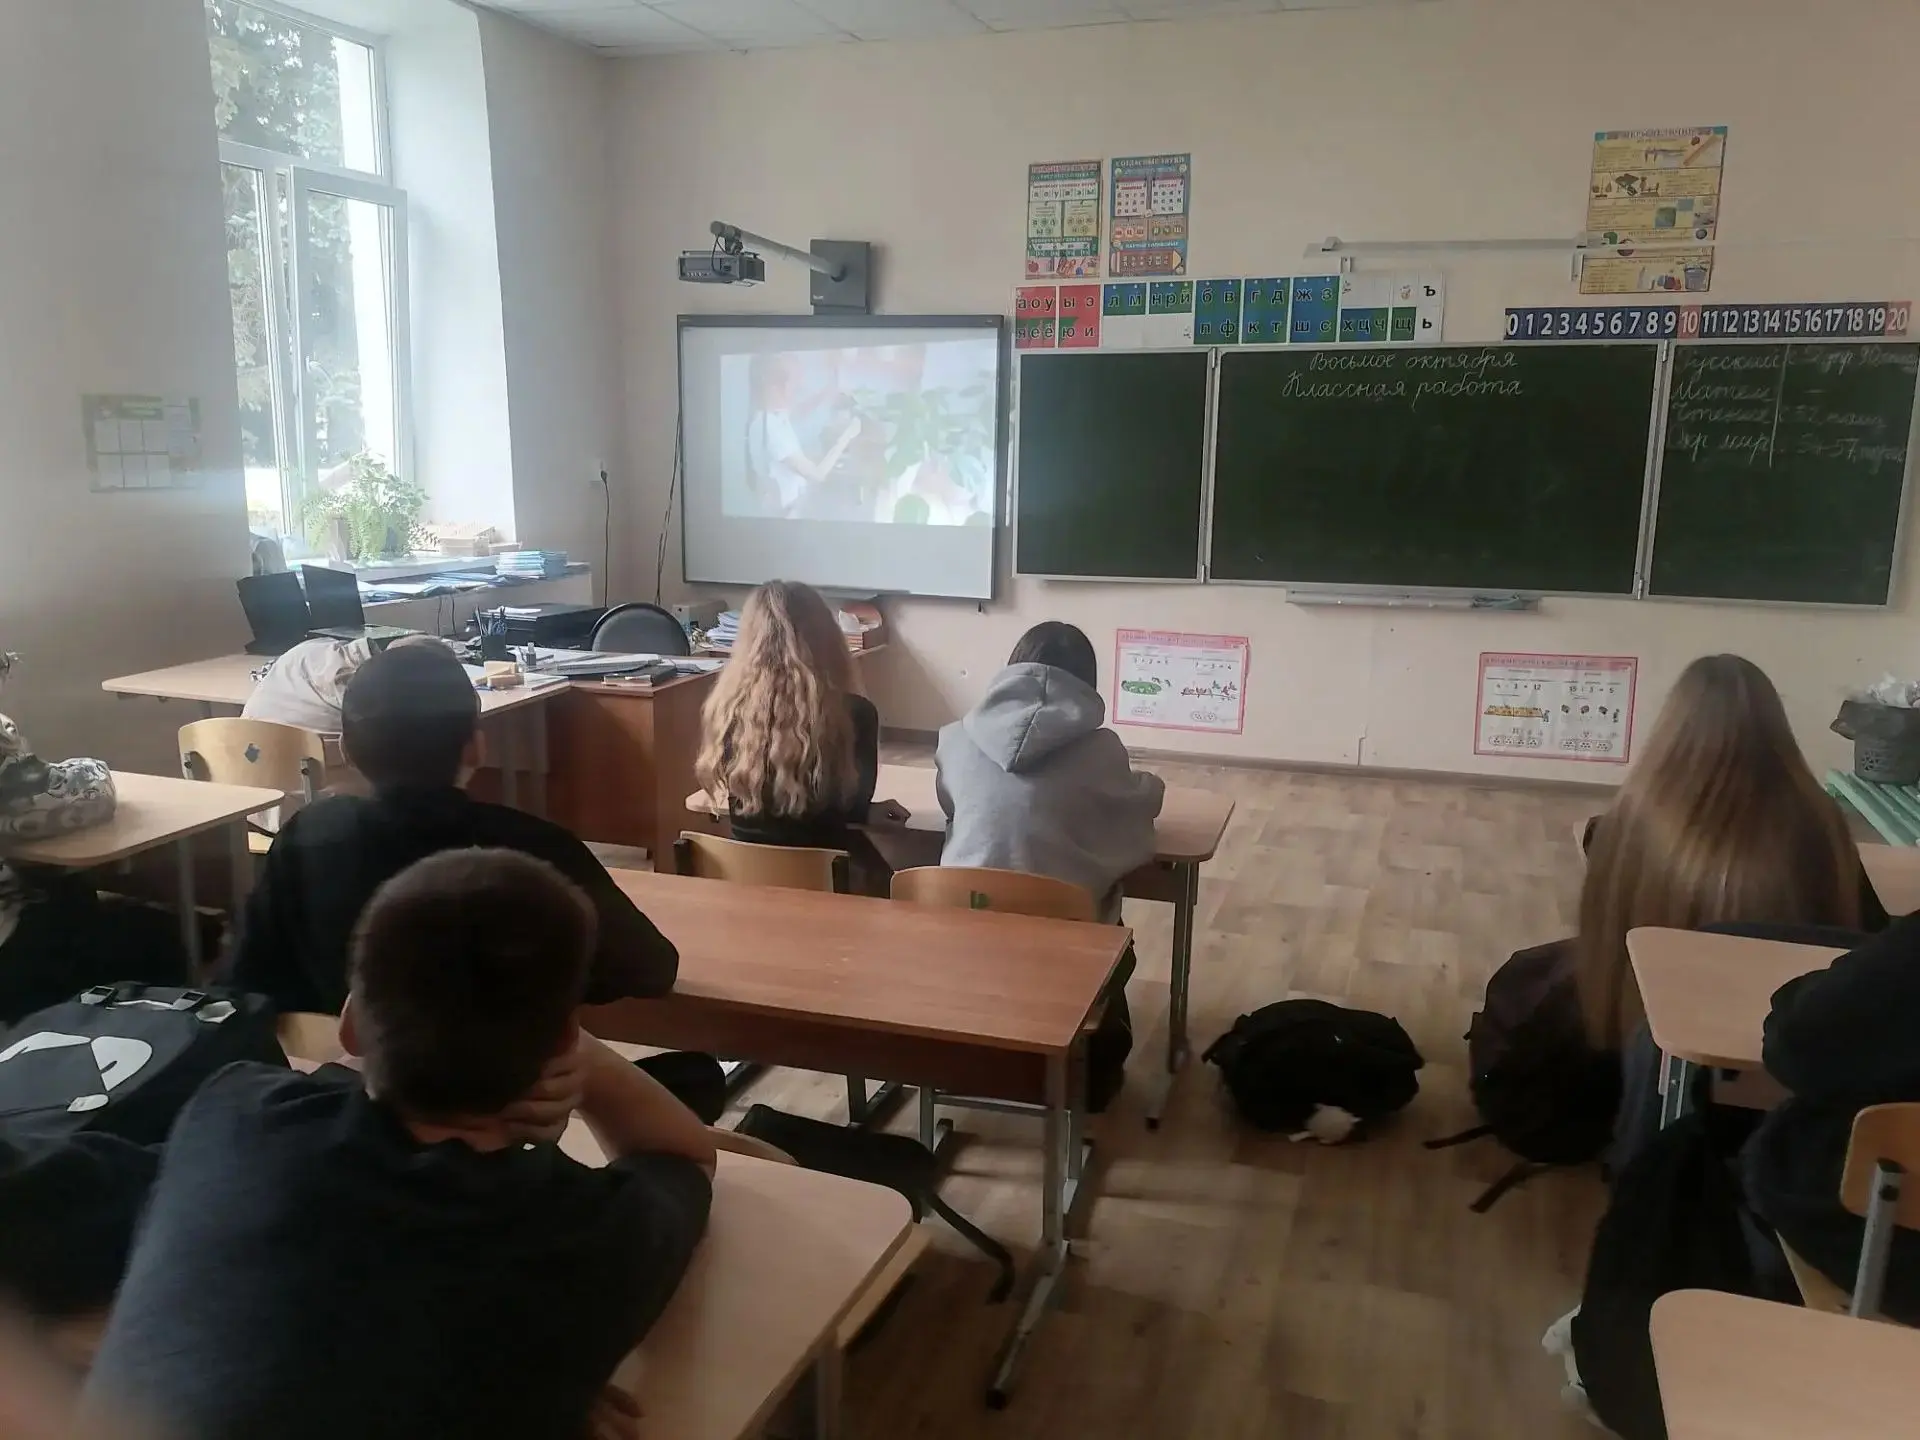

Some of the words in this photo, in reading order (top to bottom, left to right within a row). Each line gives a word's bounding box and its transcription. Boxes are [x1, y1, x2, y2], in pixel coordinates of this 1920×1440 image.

[1507, 313, 1519, 336] 0
[1525, 313, 1534, 335] 1
[1540, 313, 1553, 335] 2
[1558, 313, 1570, 335] 3
[1575, 312, 1588, 335] 4
[1592, 312, 1605, 334] 5
[1610, 312, 1622, 334] 6
[1628, 312, 1641, 334] 7
[1646, 311, 1659, 334] 8
[1664, 311, 1677, 334] 9
[1681, 311, 1698, 333] 10
[1702, 310, 1718, 333] 11
[1722, 310, 1739, 333] 12
[1743, 309, 1760, 333] 13
[1763, 309, 1780, 333] 14
[1784, 309, 1801, 332] 15
[1804, 308, 1822, 332] 16
[1825, 308, 1844, 332] 17
[1846, 308, 1864, 331] 18
[1867, 307, 1886, 331] 19
[1887, 307, 1907, 331] 20
[1310, 351, 1396, 371] Восьмое
[1406, 348, 1518, 379] октября
[1282, 370, 1406, 398] Классная
[1411, 371, 1524, 413] работа
